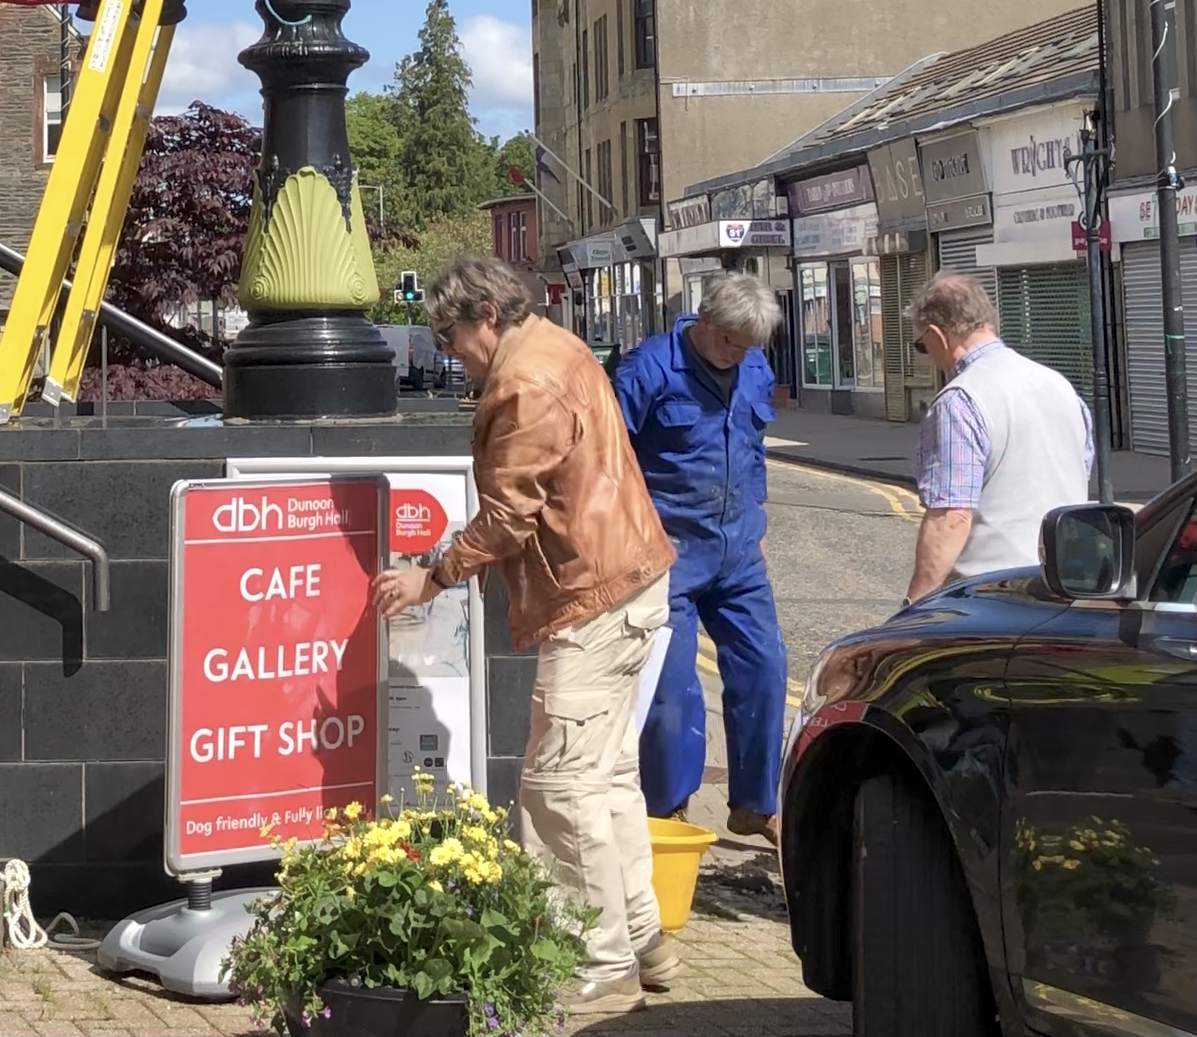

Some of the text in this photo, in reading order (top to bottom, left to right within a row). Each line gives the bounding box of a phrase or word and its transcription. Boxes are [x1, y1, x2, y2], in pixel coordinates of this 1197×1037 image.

[212, 496, 283, 532] dbh
[287, 497, 335, 511] Dunoon
[287, 509, 351, 531] Burgh Hall
[396, 503, 431, 519] dbh
[240, 564, 322, 602] CAFE
[204, 639, 349, 682] GALLERY
[190, 714, 365, 763] GIFT SHOP
[186, 820, 212, 836] Dog
[216, 812, 267, 830] friendly
[271, 812, 282, 825] &
[285, 807, 313, 825] Fully
